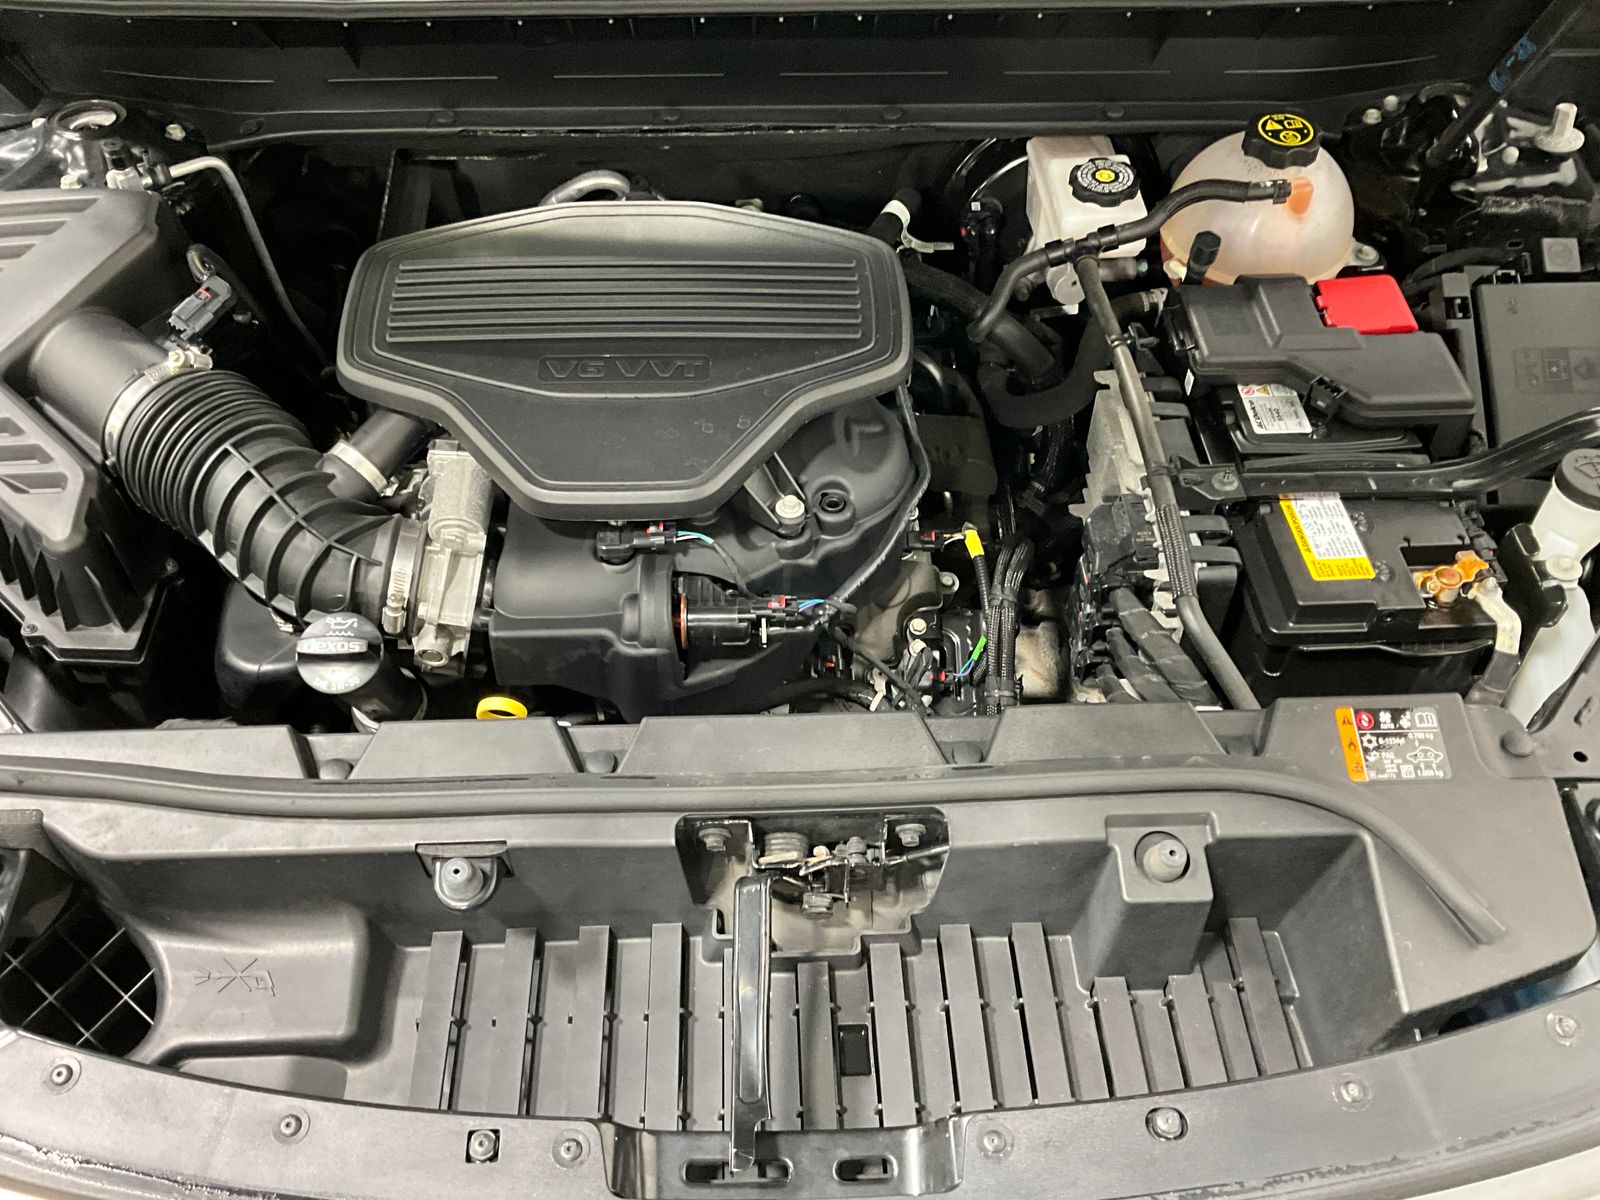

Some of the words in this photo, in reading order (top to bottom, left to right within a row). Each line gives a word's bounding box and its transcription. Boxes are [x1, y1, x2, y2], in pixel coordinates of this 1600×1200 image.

[546, 360, 605, 378] V6
[615, 360, 703, 377] VVT
[1286, 504, 1299, 524] POISON
[1295, 525, 1308, 547] DANGER
